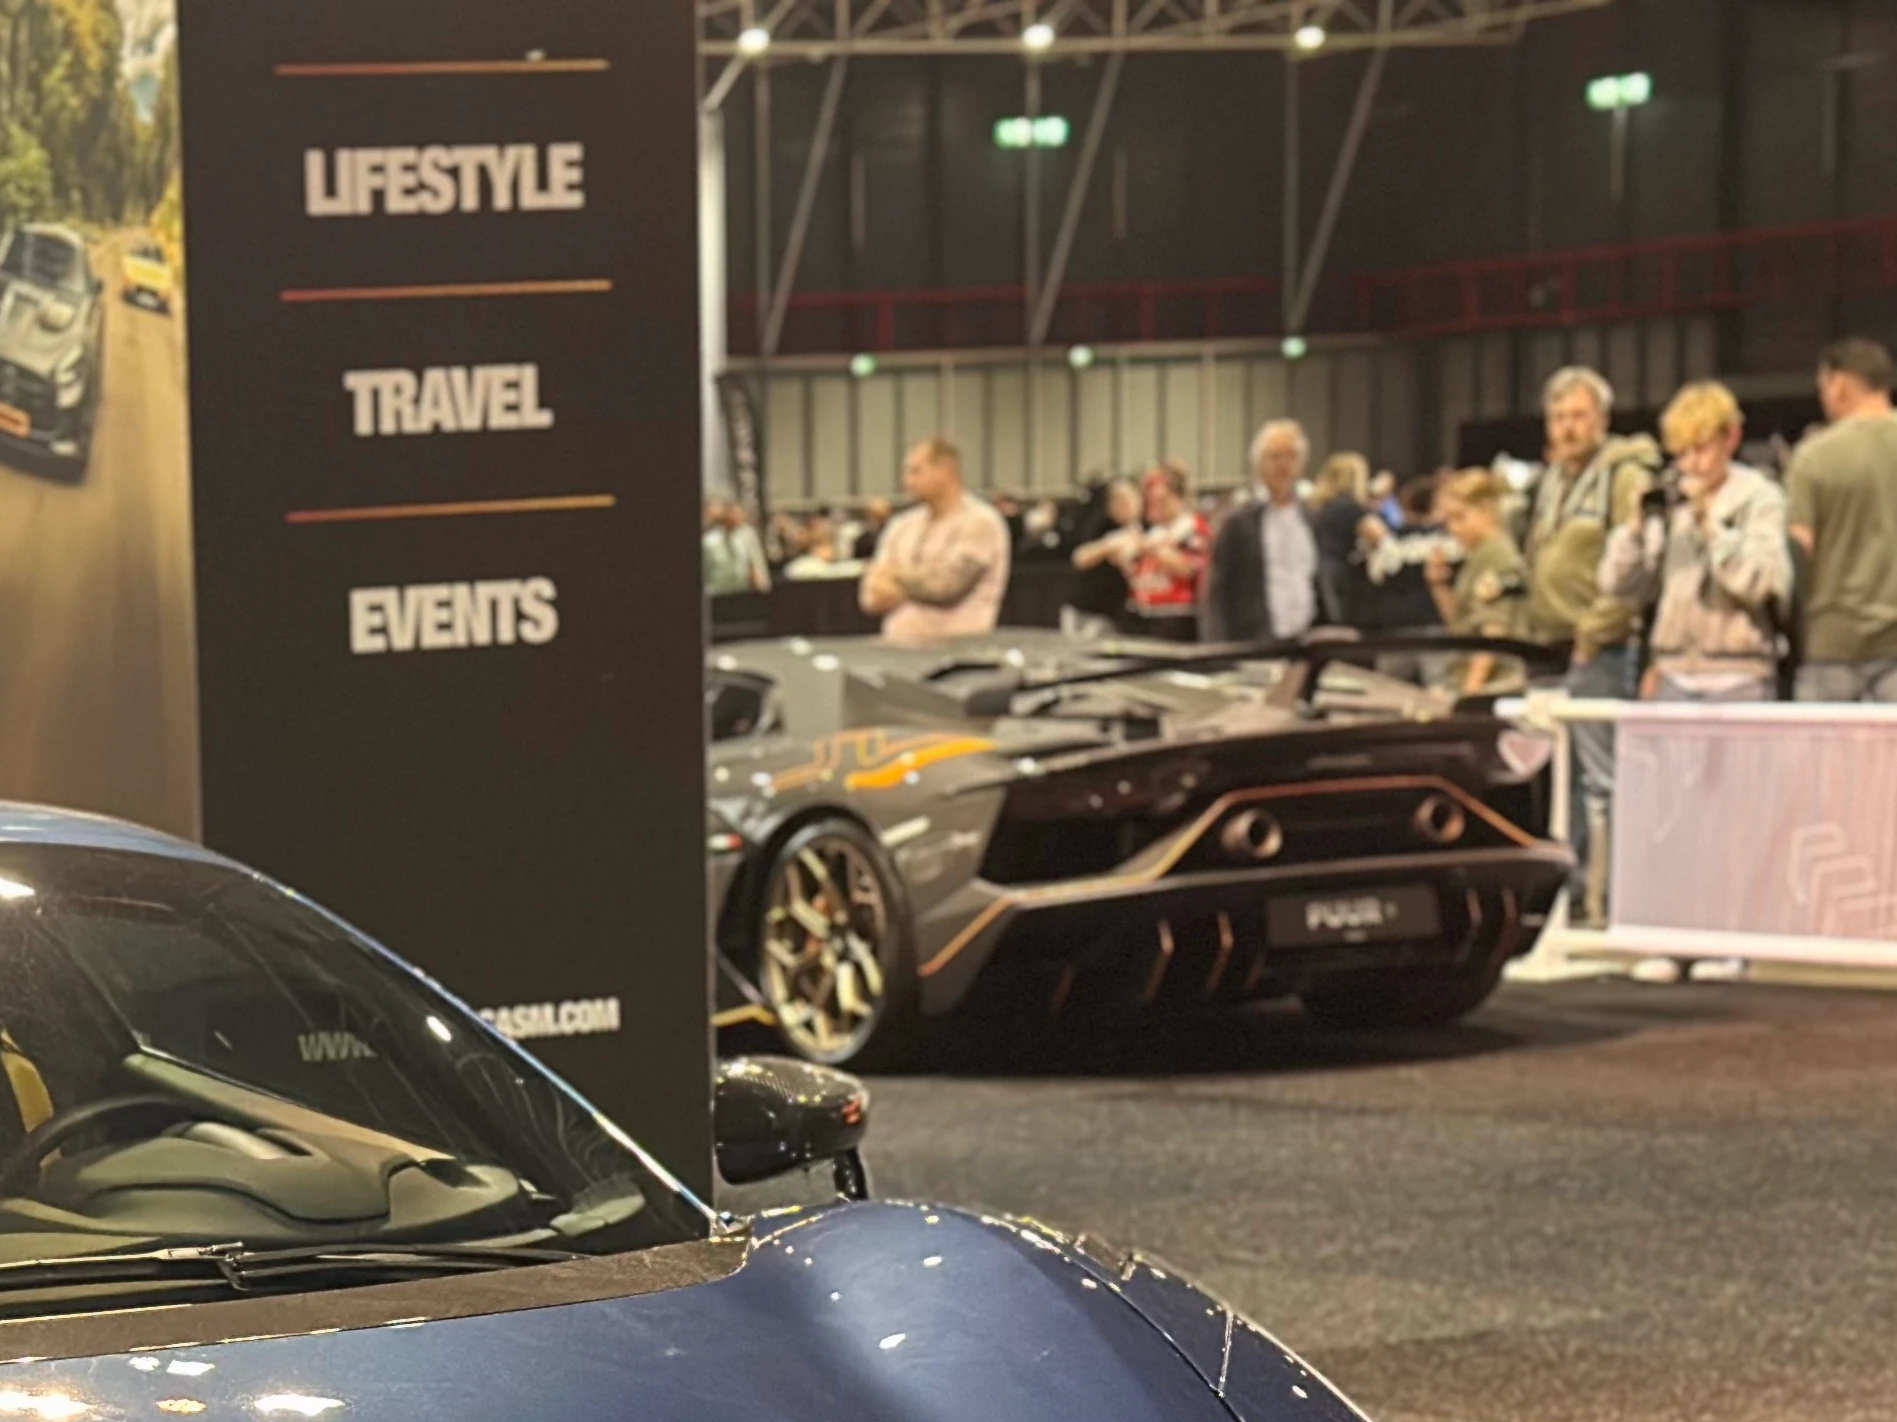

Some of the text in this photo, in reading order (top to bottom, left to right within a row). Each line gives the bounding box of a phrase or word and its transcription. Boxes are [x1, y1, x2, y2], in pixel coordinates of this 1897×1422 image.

[304, 143, 585, 216] LIFESTYLE
[344, 364, 554, 437] TRAVEL
[350, 577, 558, 654] EVENTS
